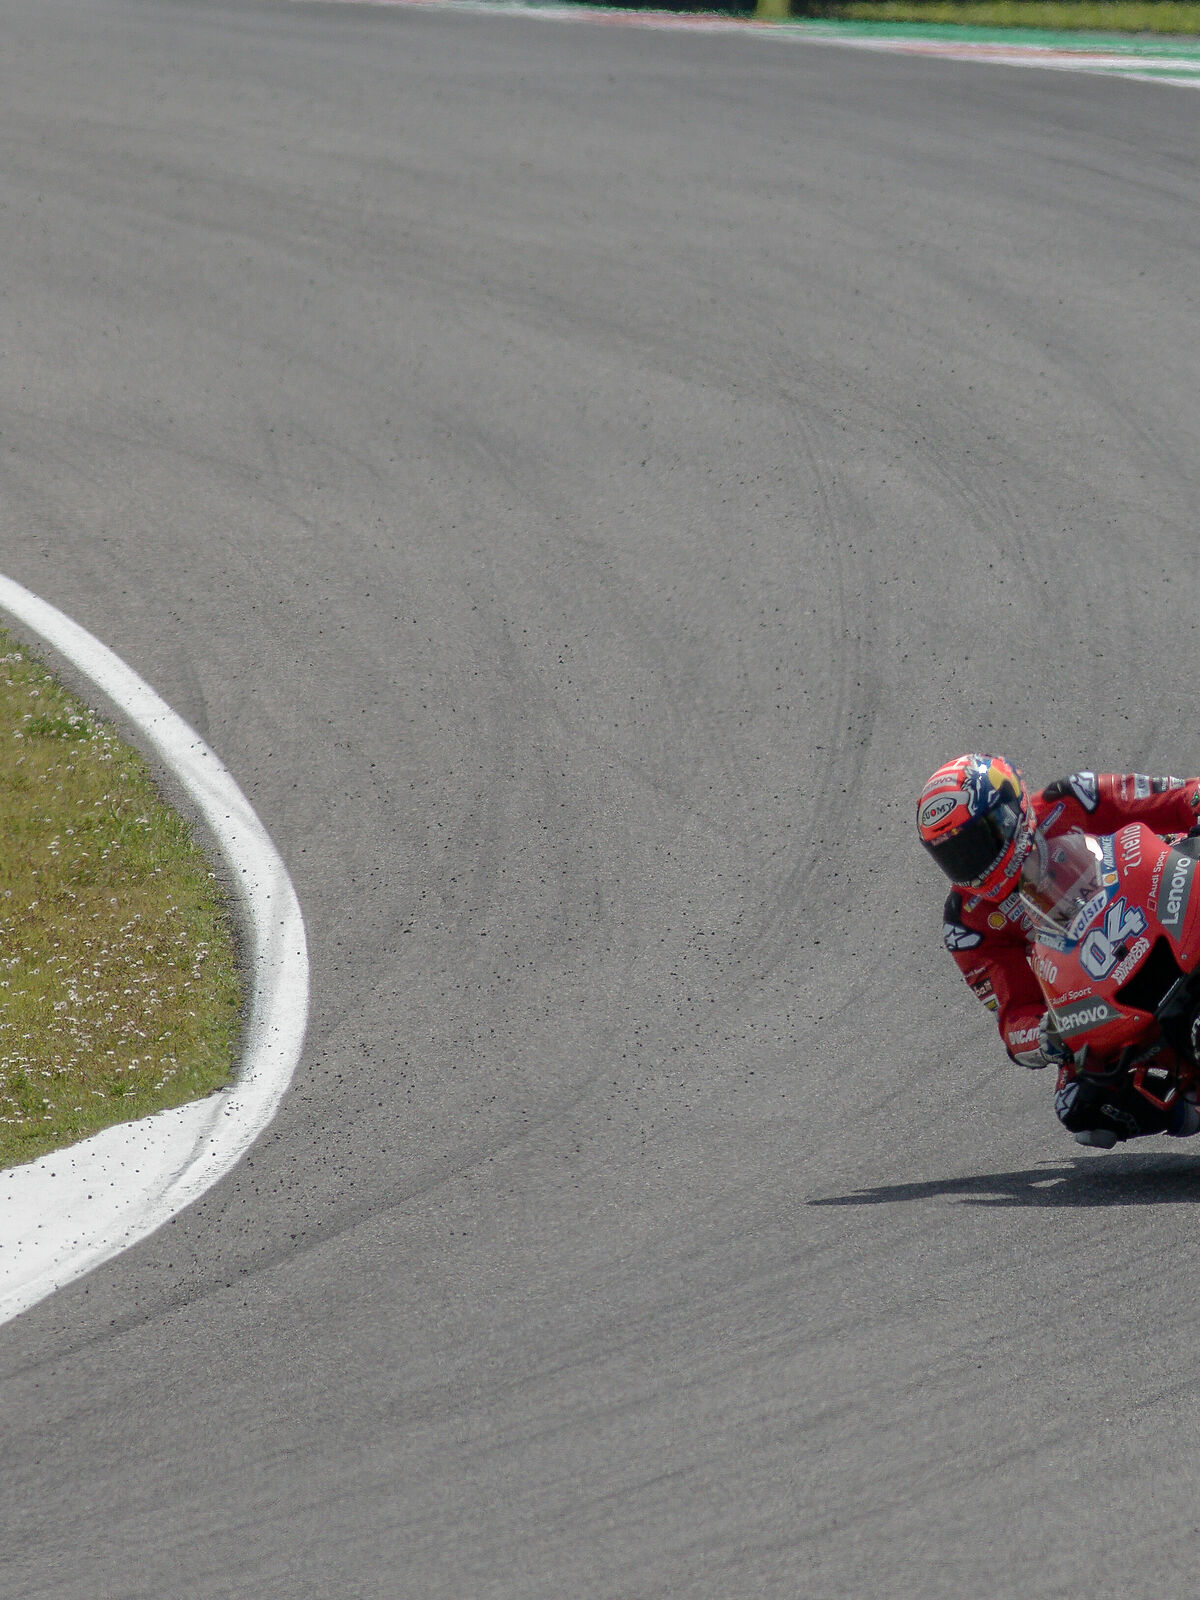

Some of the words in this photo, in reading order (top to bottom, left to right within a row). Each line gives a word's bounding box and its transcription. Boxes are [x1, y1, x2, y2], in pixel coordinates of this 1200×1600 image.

[922, 801, 956, 824] SUOMY
[1104, 835, 1113, 868] ADVANCE
[1153, 850, 1168, 874] Sport
[1150, 873, 1159, 898] Audi
[1161, 857, 1192, 926] Lenovo
[1073, 896, 1106, 938] valsir
[1080, 896, 1148, 981] 04
[1068, 987, 1092, 1001] Sport
[1057, 1005, 1108, 1033] Lenovo
